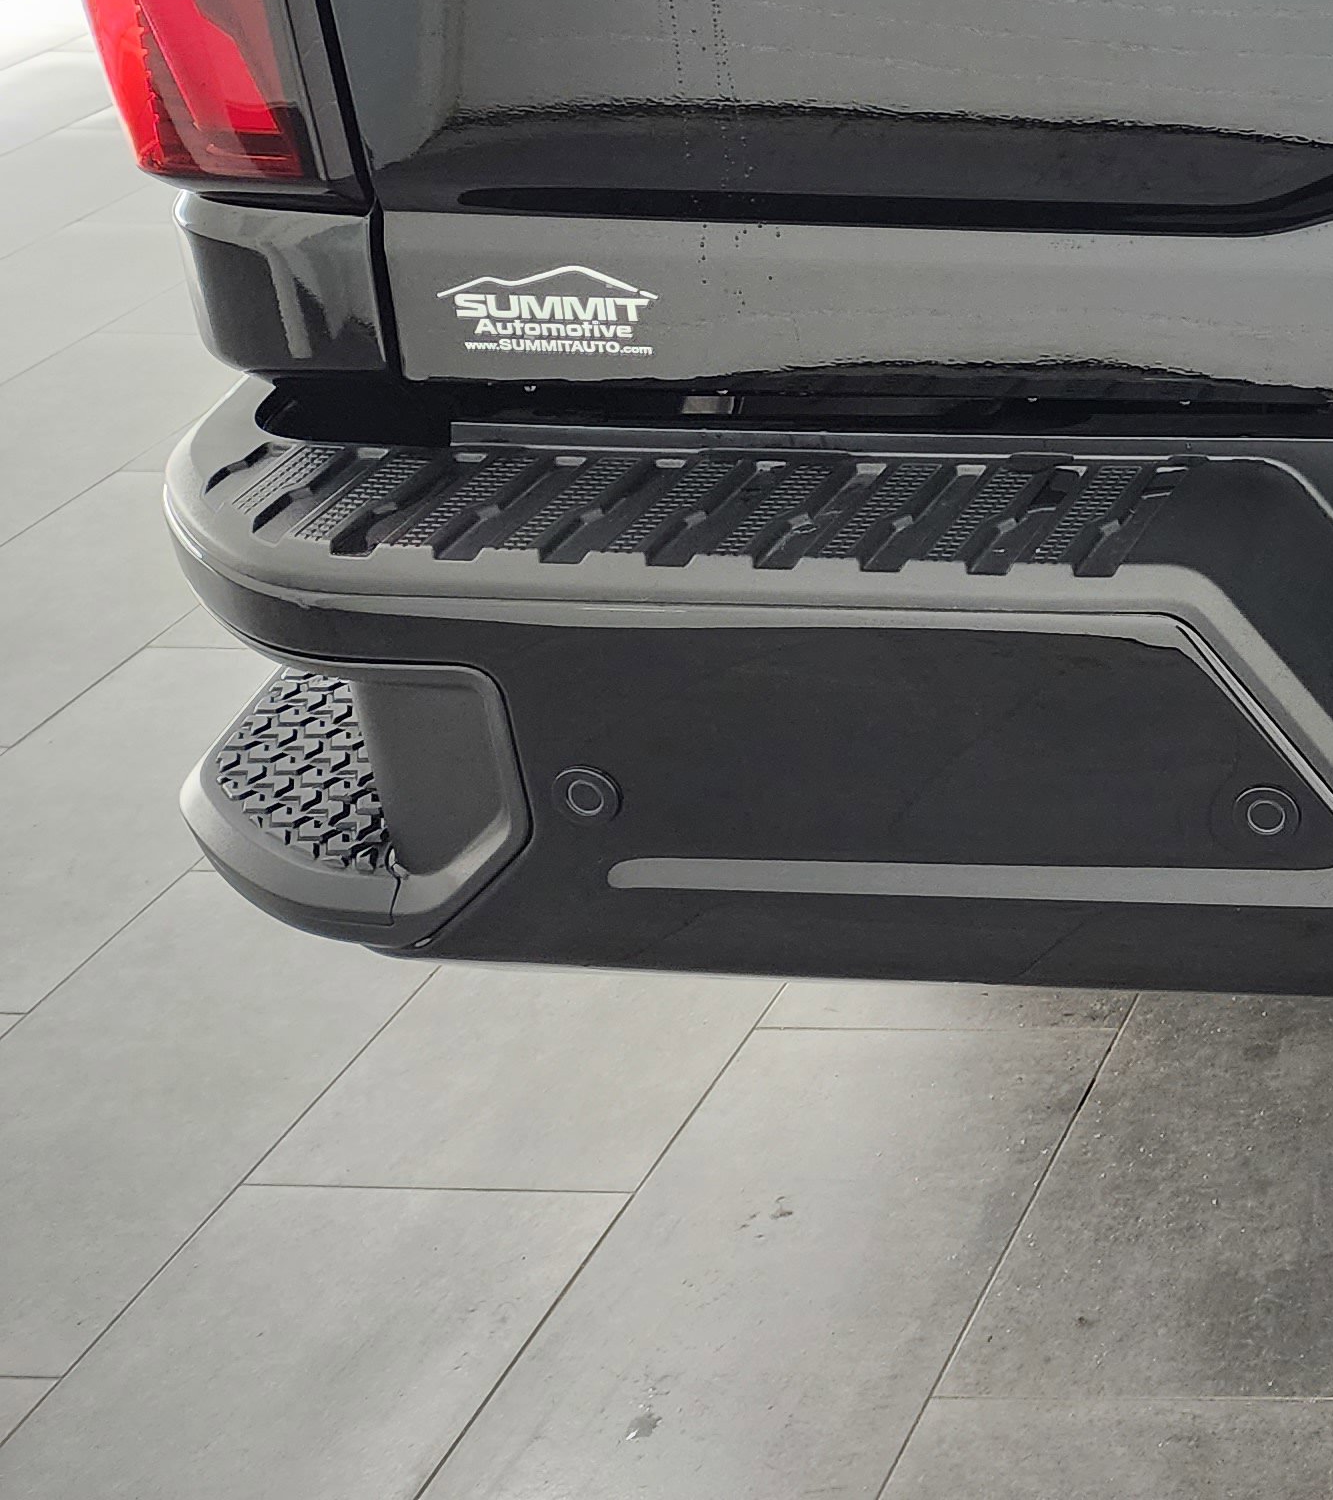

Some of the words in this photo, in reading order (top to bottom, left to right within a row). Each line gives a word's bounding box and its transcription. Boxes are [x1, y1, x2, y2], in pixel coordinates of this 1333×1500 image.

[454, 293, 650, 322] SUMMIT
[474, 318, 633, 338] Automotive
[464, 338, 654, 355] www.SUMMITAUTO.com
